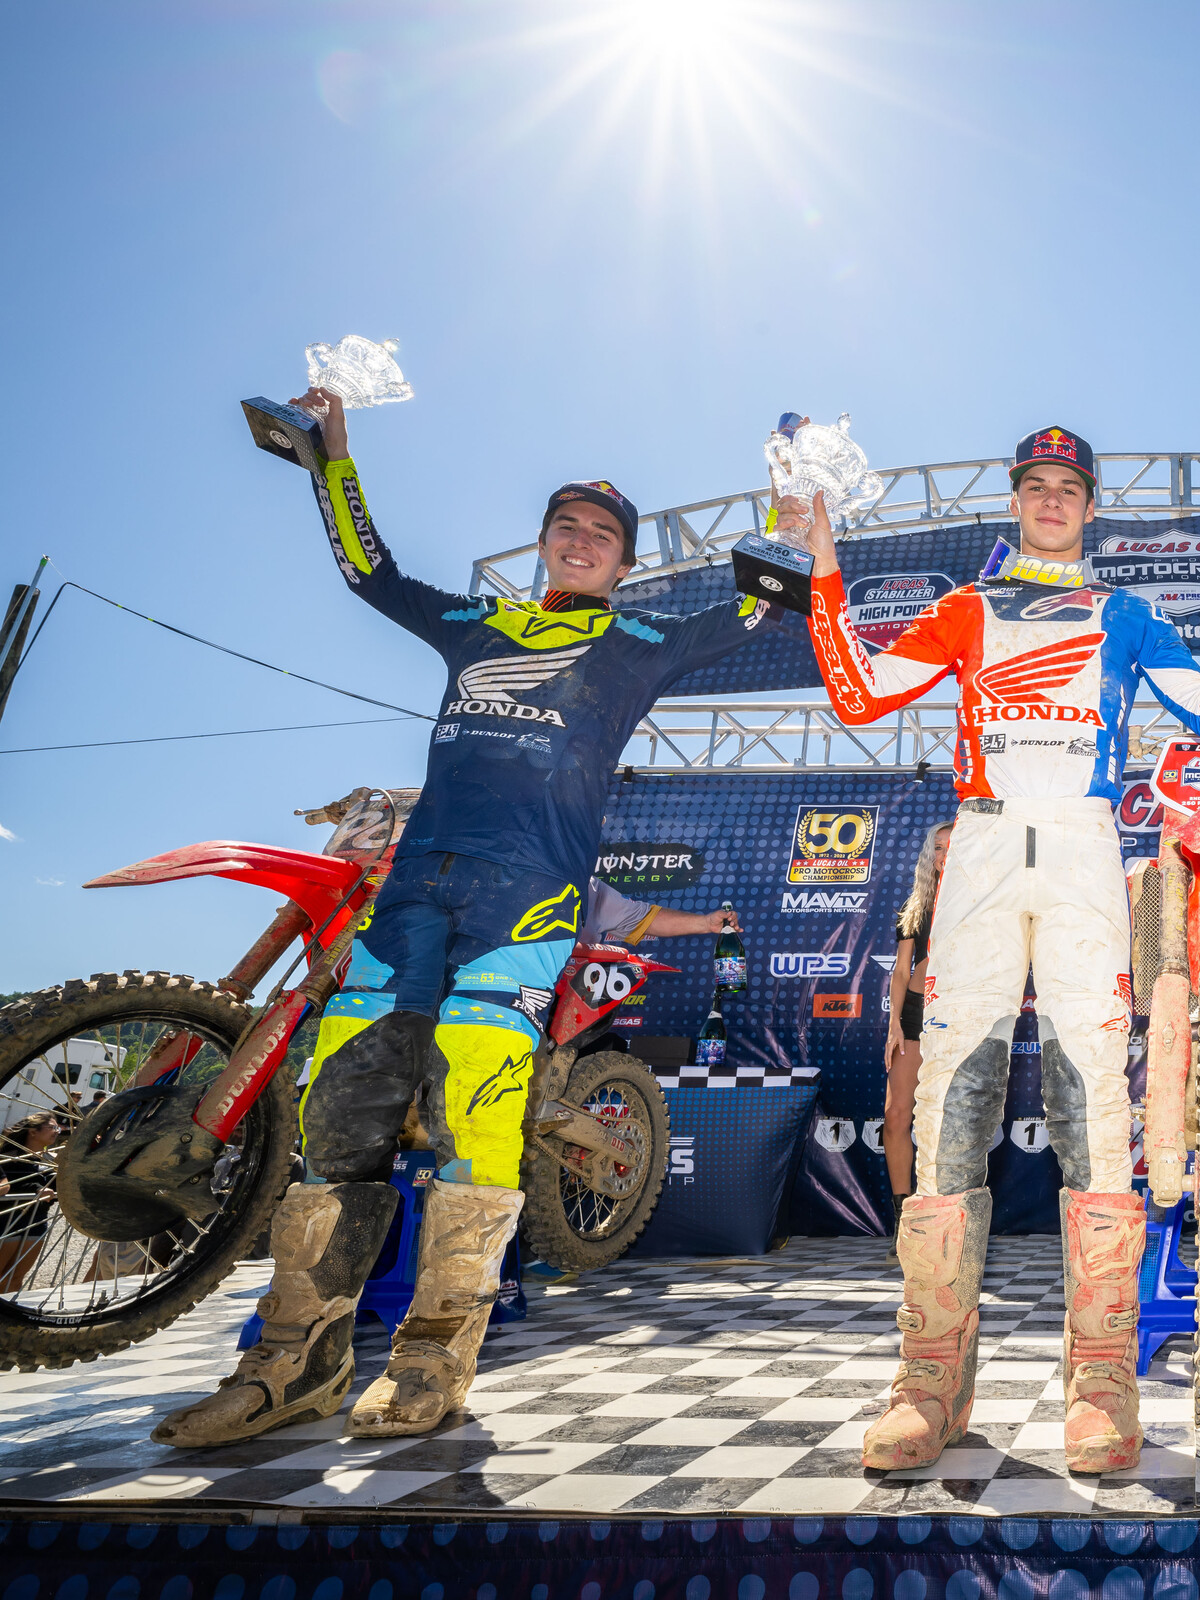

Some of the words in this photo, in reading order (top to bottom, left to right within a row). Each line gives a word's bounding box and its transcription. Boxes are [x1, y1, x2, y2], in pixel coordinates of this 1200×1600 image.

[1032, 445, 1053, 457] Red
[1056, 448, 1077, 462] Bull
[341, 477, 383, 571] HONDA
[765, 544, 790, 557] 250
[1116, 541, 1191, 553] LUCAS
[749, 545, 775, 559] OVERALL
[777, 555, 801, 567] WINNER
[1010, 557, 1084, 586] 100%
[883, 579, 926, 590] LUCAS
[867, 589, 933, 600] STABILIZER
[1155, 593, 1185, 601] AMA
[858, 606, 891, 621] HIGH
[859, 622, 911, 632] NATION
[444, 700, 567, 728] HONDA
[975, 705, 1105, 727] HONDA
[471, 730, 516, 739] DUNLOP
[805, 813, 867, 854] 50
[782, 893, 869, 909] MAVTV
[588, 943, 625, 954] HONDA
[772, 955, 850, 976] WPS
[480, 973, 495, 982] 63
[583, 962, 632, 1000] 96
[822, 1000, 854, 1012] KTM
[512, 999, 544, 1032] HONDA
[216, 1020, 287, 1117] DUNLOP
[611, 1137, 625, 1152] DID
[417, 1170, 431, 1180] 50
